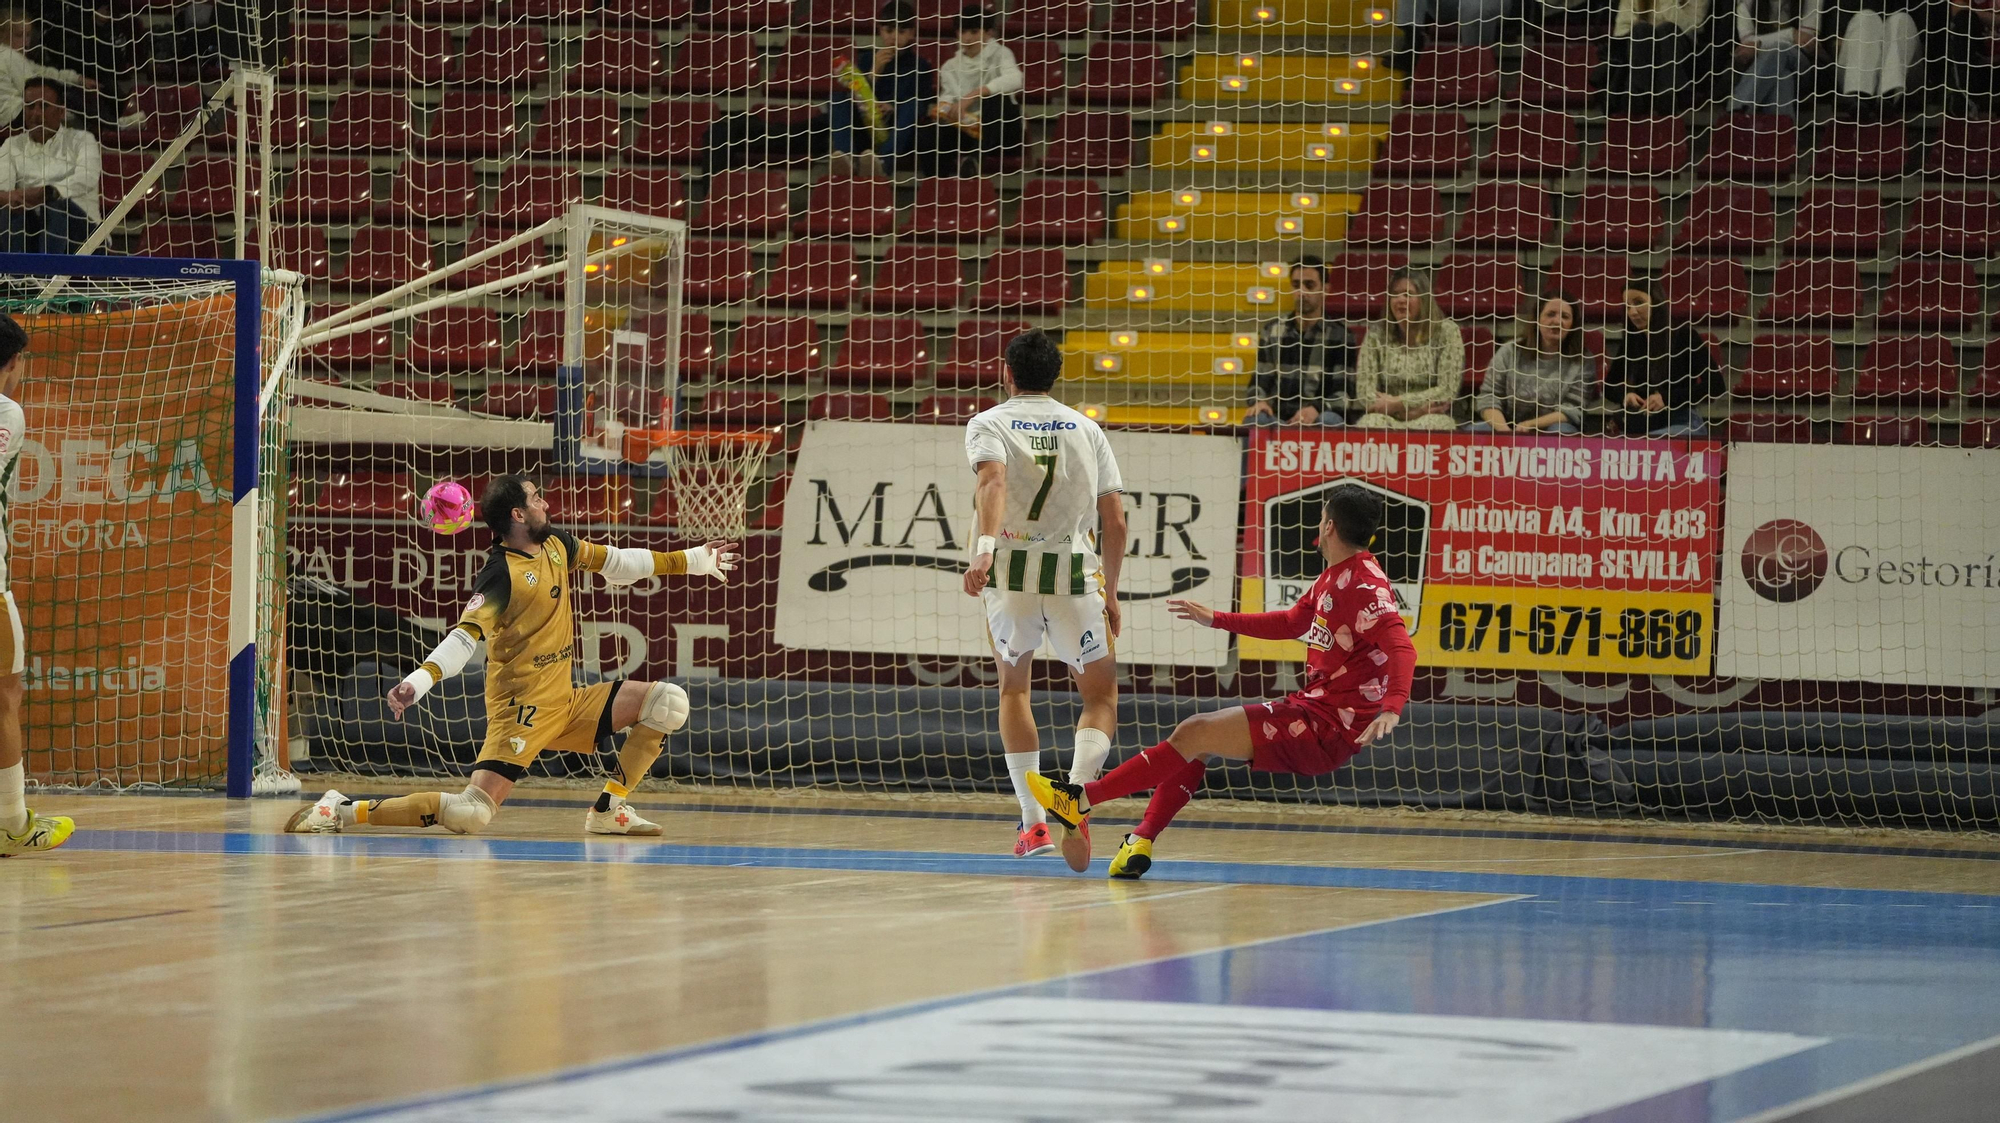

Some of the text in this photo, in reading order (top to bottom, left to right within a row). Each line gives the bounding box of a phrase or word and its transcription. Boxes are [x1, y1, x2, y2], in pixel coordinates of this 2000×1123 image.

[180, 267, 221, 275] COADE
[1011, 419, 1077, 431] Revalco
[1029, 435, 1059, 451] ZEQUI
[1265, 437, 1399, 474] ESTACIÓN
[1406, 444, 1441, 475] DE
[1448, 445, 1592, 479] SERVICIOS
[1600, 449, 1676, 482] RUTA
[1026, 455, 1058, 521] 7
[806, 479, 1208, 560] MAER
[1600, 507, 1647, 538] Km.
[1653, 509, 1706, 539] 483
[1442, 544, 1701, 581] La Campana SEVILLA
[1439, 602, 1702, 660] 671-671-868
[516, 704, 537, 728] 12
